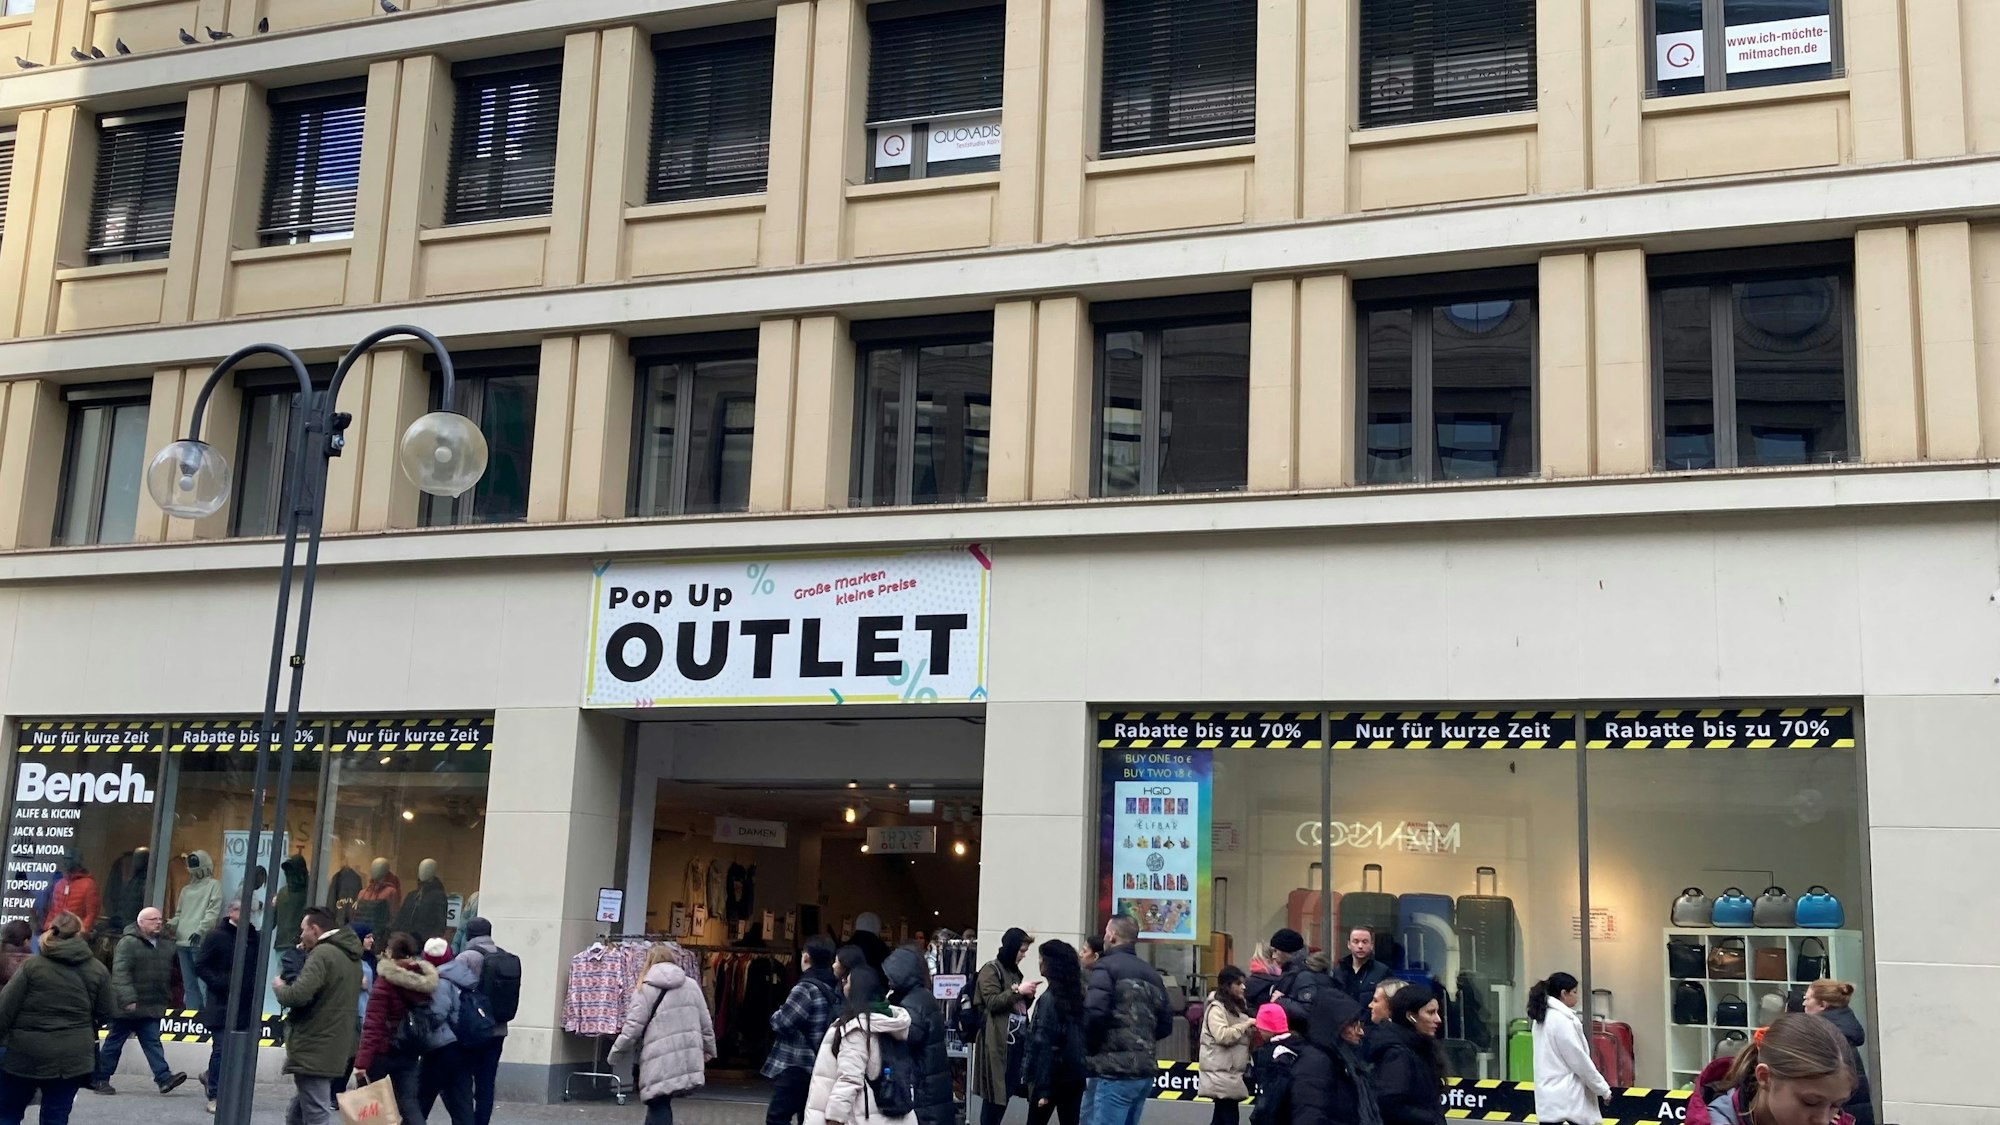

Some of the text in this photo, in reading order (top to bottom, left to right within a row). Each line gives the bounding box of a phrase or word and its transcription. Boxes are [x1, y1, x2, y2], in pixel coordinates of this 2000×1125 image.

[1727, 29, 1828, 47] www.ich-möchte-
[1738, 43, 1818, 61] mitmachen.de
[609, 583, 733, 614] Pop Up
[793, 583, 831, 600] Große
[836, 578, 917, 606] kleine Preise
[605, 614, 968, 683] OUTLET
[346, 728, 479, 743] Nur für kurze Zeit
[1114, 722, 1301, 739] Rabatte bis zu 70%
[1355, 722, 1550, 739] Nur für kurze Zeit
[1605, 719, 1829, 738] Rabatte bis zu 70%
[33, 731, 149, 744] Nur für kurze Zeit
[182, 730, 235, 743] Rabatte
[239, 729, 260, 743] bis
[1125, 754, 1146, 763] BUY
[1148, 754, 1170, 763] ONE
[1124, 768, 1145, 778] BUY
[1147, 768, 1171, 778] TWO
[16, 763, 155, 803] Bench.
[1143, 787, 1171, 795] HQD
[15, 808, 81, 819] ALIFE & KICKIN
[13, 826, 74, 838] JACK & JONES
[738, 826, 777, 837] DAMEN
[11, 844, 65, 855] CASA MODA
[7, 862, 57, 873] NAKETANO
[6, 880, 49, 891] TOPSHOP
[3, 897, 36, 909] REPLAY
